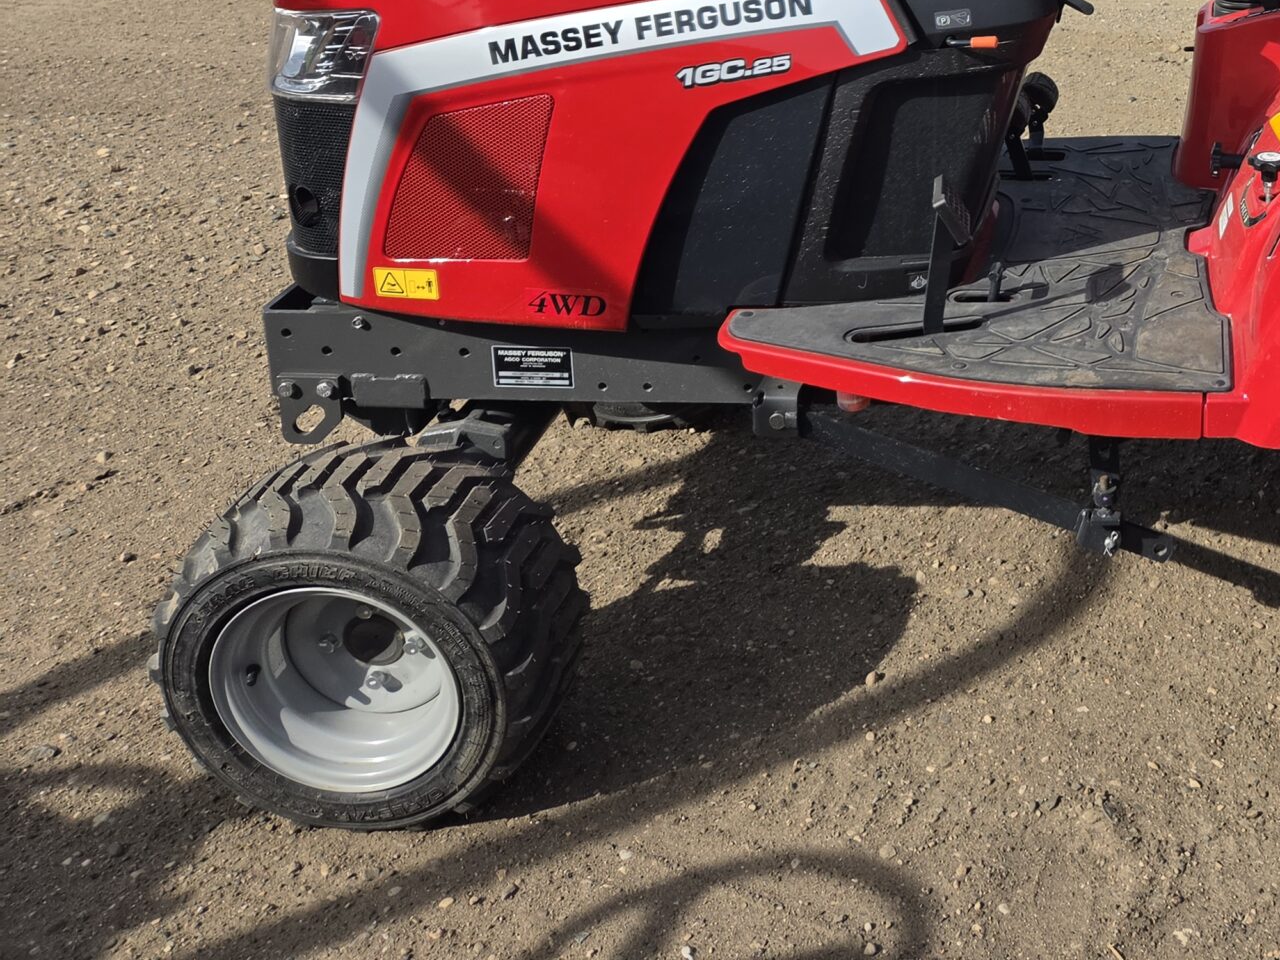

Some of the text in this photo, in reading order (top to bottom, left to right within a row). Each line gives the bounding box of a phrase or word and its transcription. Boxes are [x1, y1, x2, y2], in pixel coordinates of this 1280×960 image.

[487, 19, 624, 65] MASSEY
[675, 53, 791, 89] 1GC.25
[528, 291, 607, 317] 4WD
